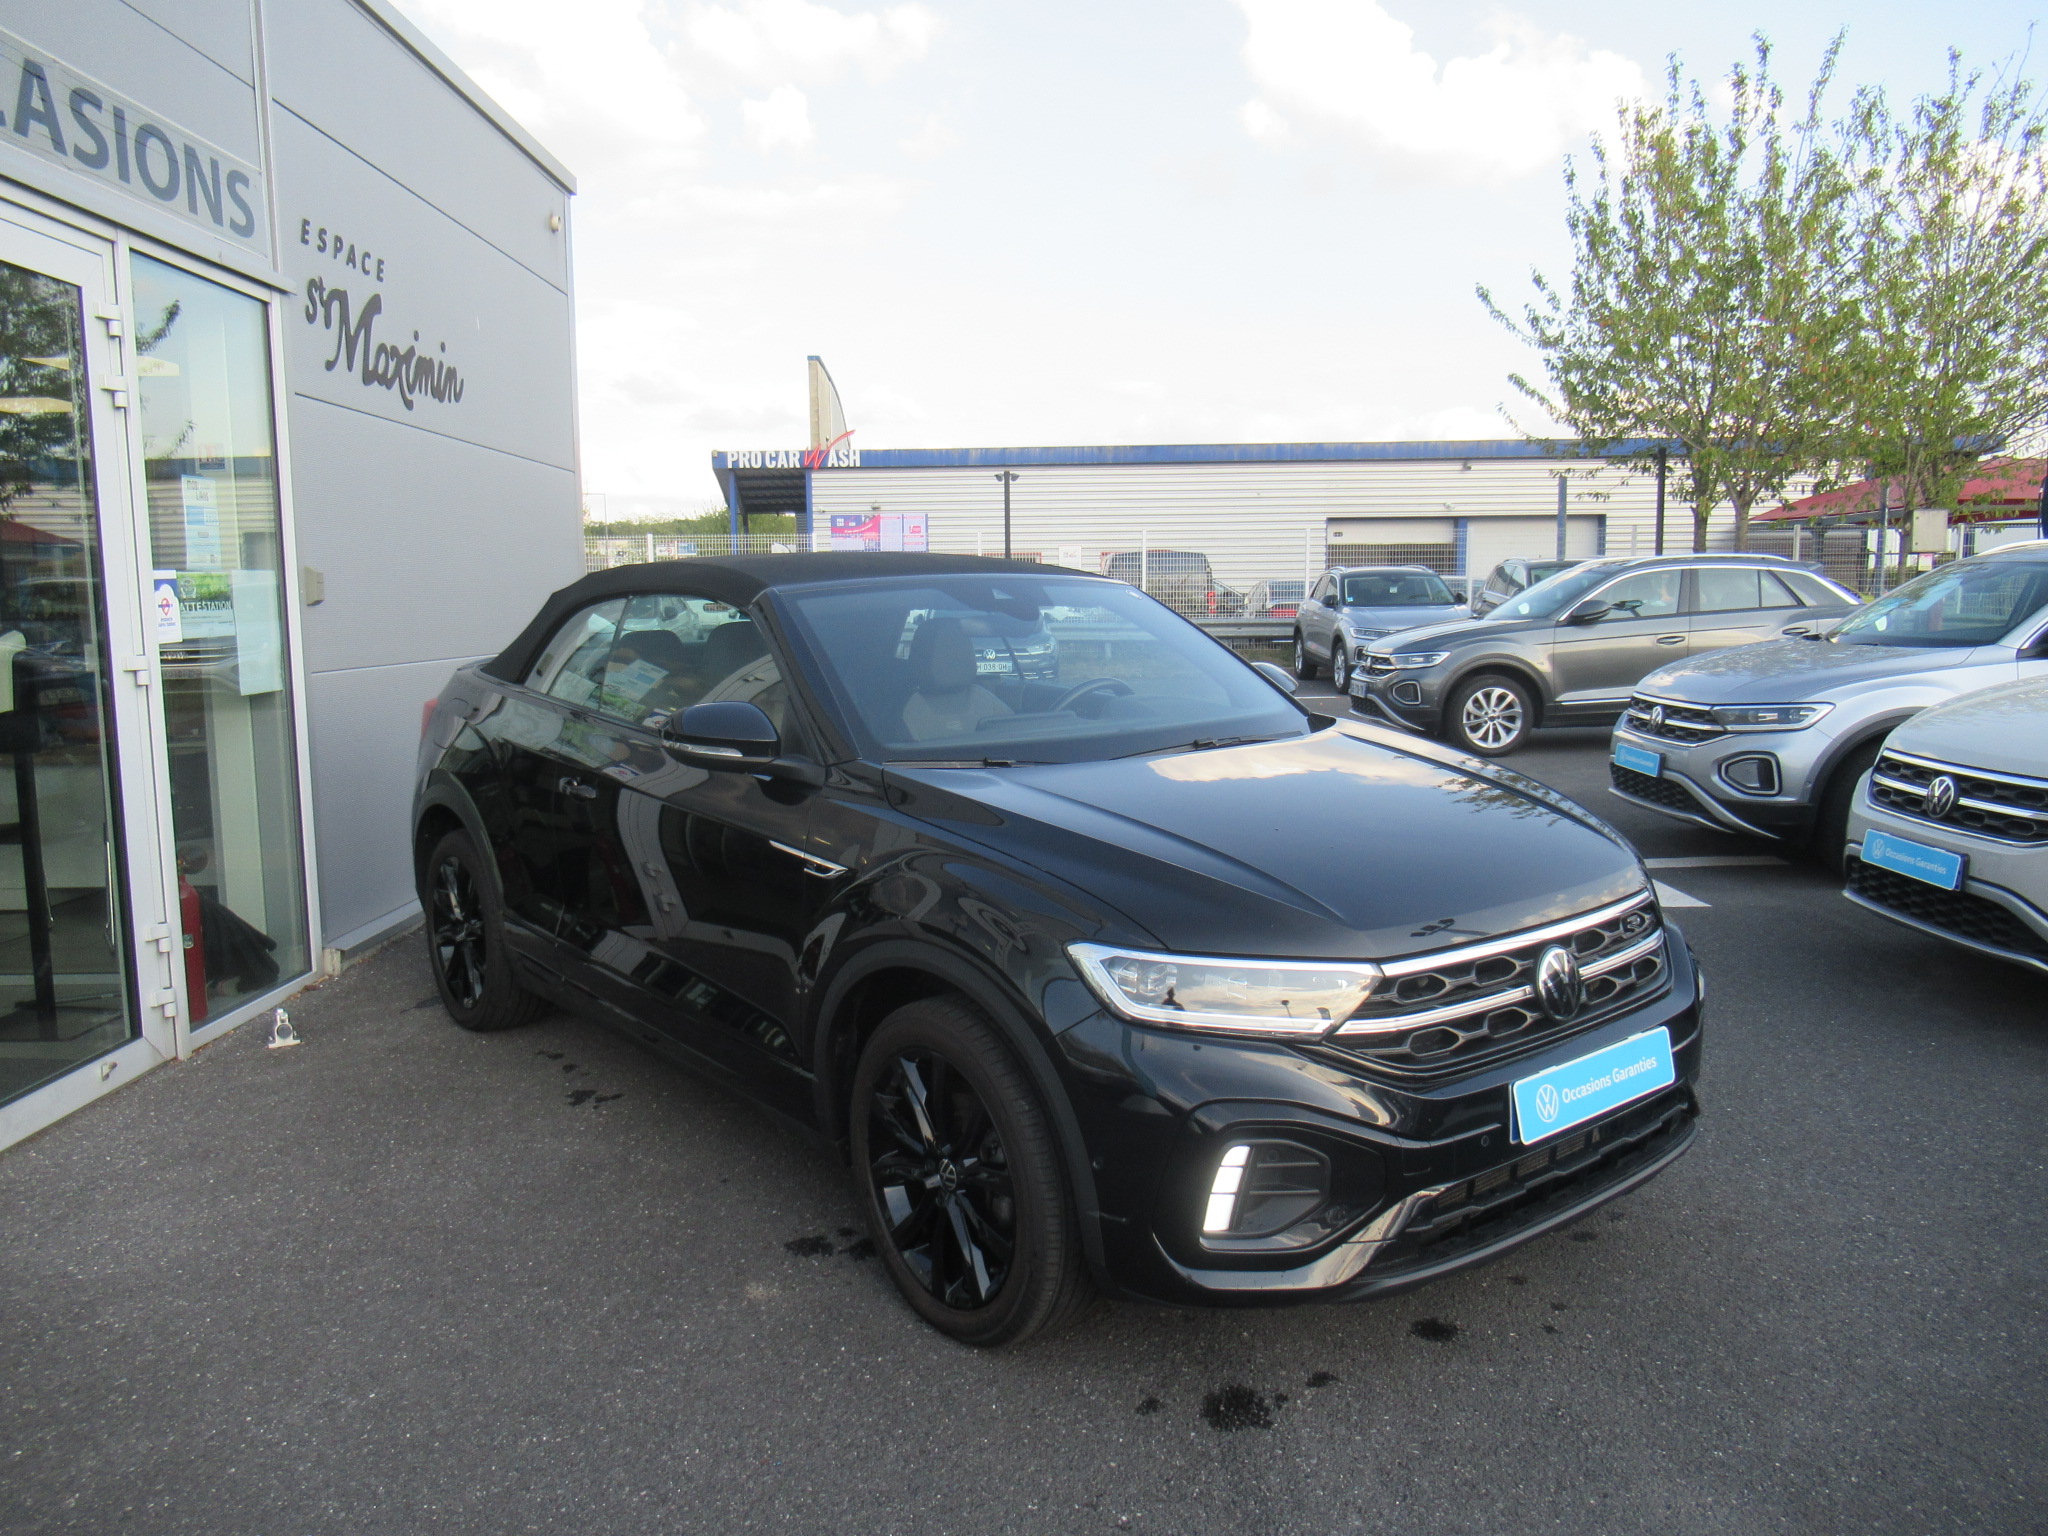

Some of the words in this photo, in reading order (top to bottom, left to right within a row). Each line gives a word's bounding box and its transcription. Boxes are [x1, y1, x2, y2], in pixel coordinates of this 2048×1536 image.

[0, 58, 256, 238] ASIONS
[301, 218, 385, 283] ESPACE
[324, 288, 464, 411] Maximin
[727, 450, 762, 469] PRO
[765, 450, 801, 469] CAR
[803, 429, 861, 470] WASH
[179, 600, 233, 612] ATTESTATION
[1561, 1075, 1612, 1104] Occasions
[1612, 1055, 1658, 1084] Garanties
